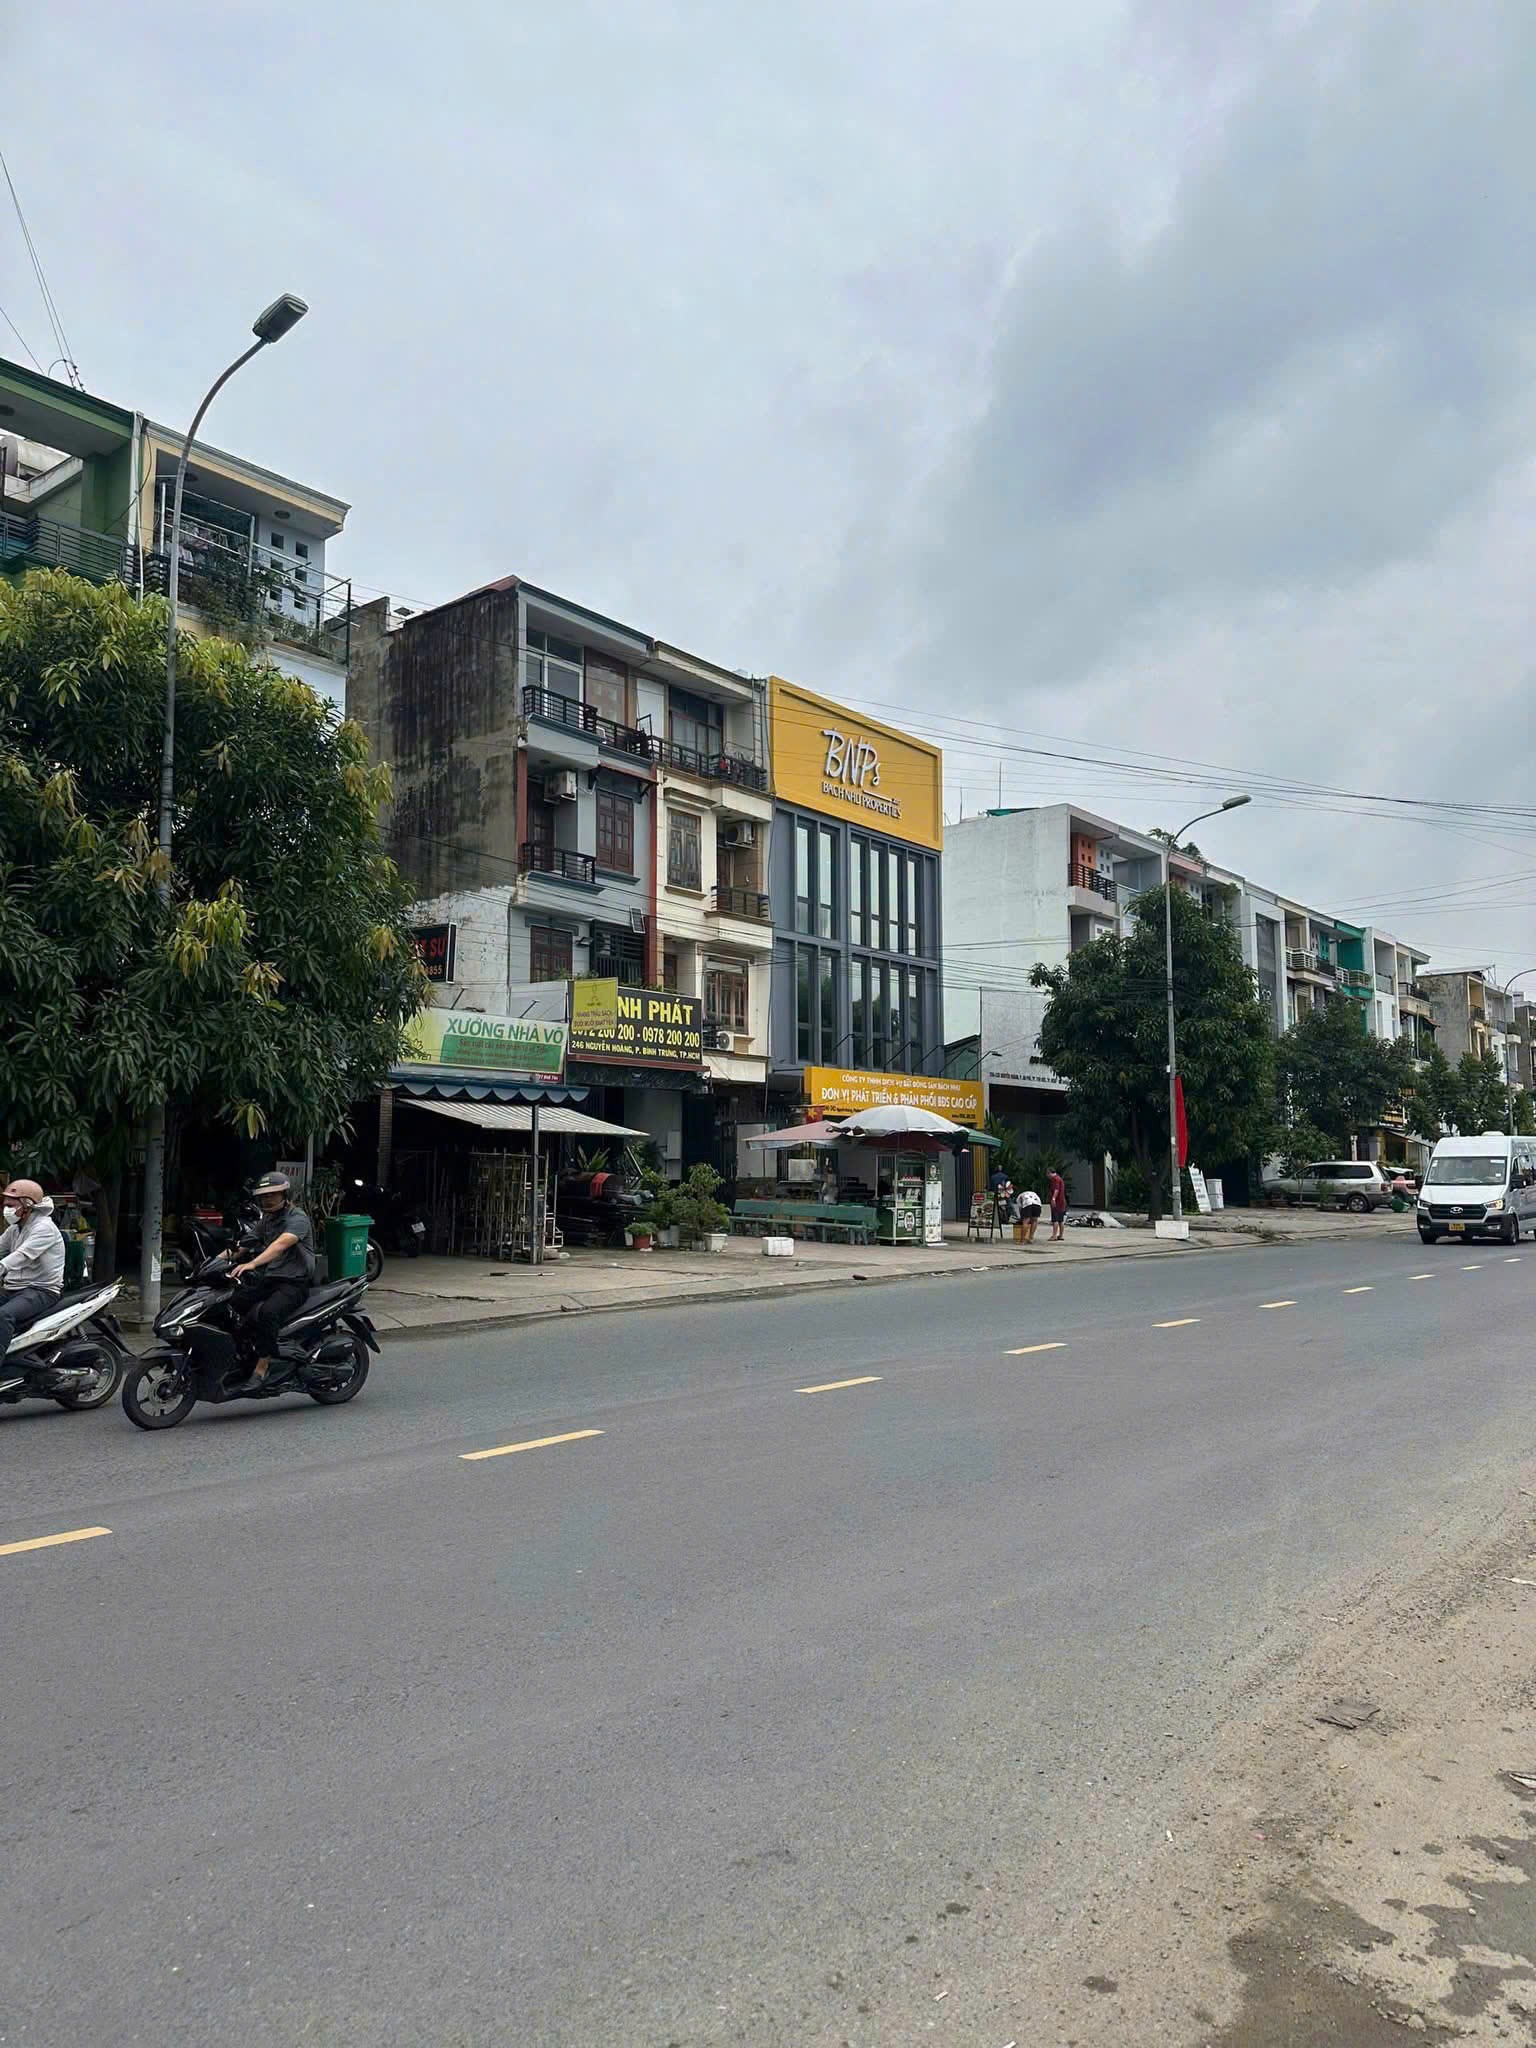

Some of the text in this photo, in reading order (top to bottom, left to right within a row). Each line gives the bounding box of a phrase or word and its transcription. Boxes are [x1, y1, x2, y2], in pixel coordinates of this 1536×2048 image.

[861, 795, 903, 820] PROPERTIES
[616, 996, 694, 1026] NH PHÁT
[447, 1016, 506, 1038] XƯỞNG
[508, 1022, 540, 1042] NHÀ
[618, 1023, 635, 1041] 200
[643, 1025, 665, 1044] 0978
[666, 1028, 682, 1046] 200
[684, 1031, 700, 1049] 200
[572, 1040, 585, 1050] 246
[841, 1074, 857, 1084] CÔNG
[858, 1076, 866, 1084] TY
[821, 1087, 840, 1101] ĐƠN
[841, 1088, 850, 1104] VỊ
[851, 1087, 870, 1103] PHÁT
[871, 1086, 893, 1105] TRIỂN
[893, 1092, 899, 1105] &
[951, 1096, 965, 1109] CAO
[965, 1093, 978, 1110] CẤP
